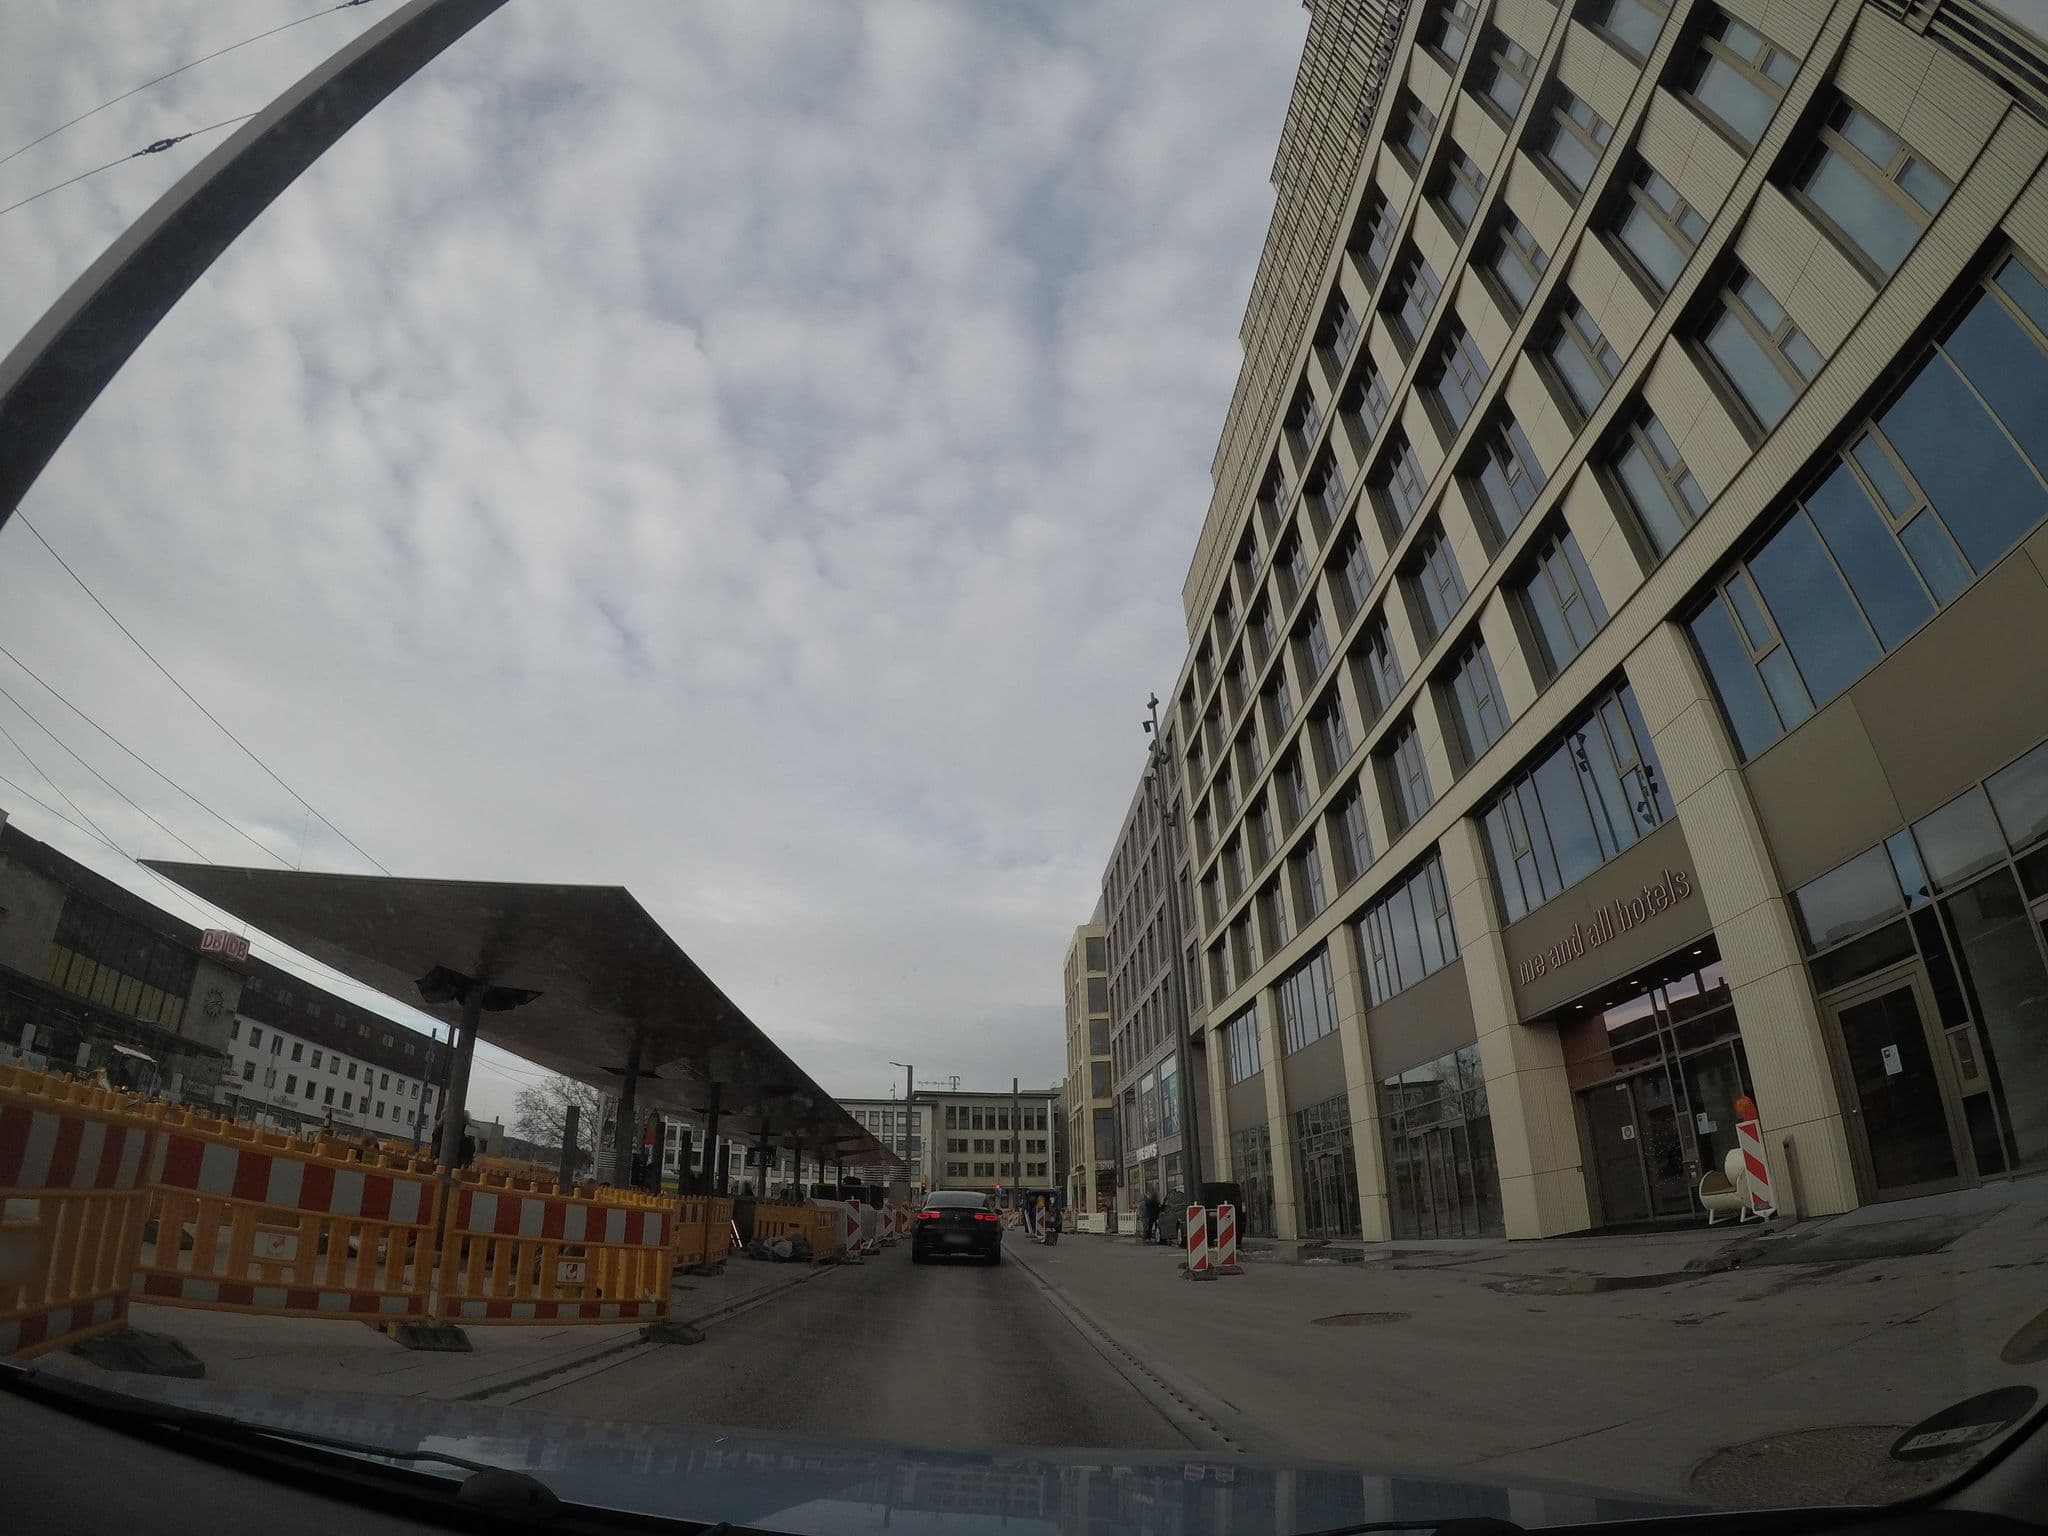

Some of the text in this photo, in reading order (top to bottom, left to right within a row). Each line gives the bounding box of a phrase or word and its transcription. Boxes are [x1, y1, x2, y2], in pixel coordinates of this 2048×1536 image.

[1518, 868, 1692, 986] me and all hotels
[202, 933, 224, 949] DB
[227, 936, 248, 959] DB
